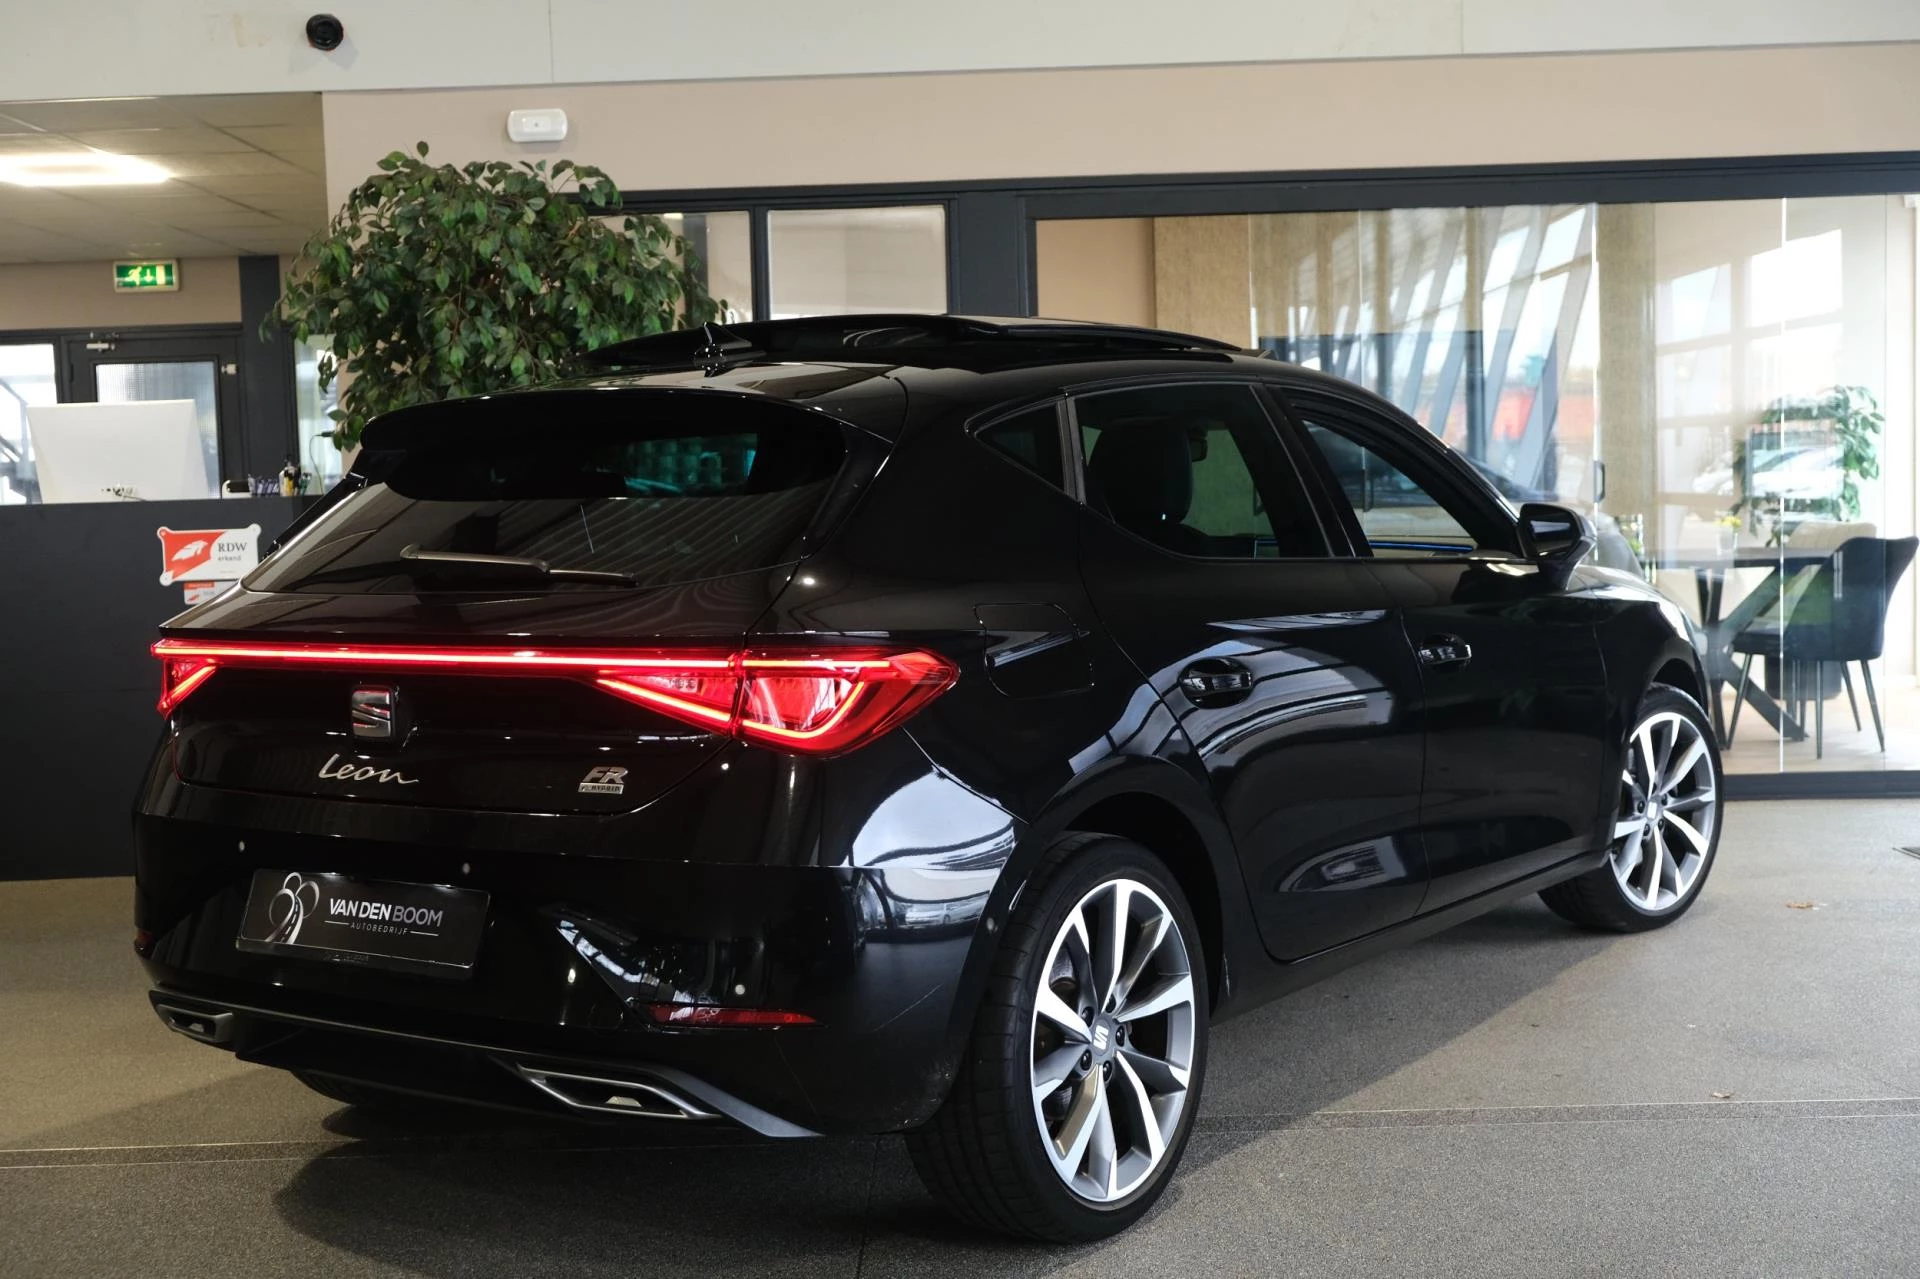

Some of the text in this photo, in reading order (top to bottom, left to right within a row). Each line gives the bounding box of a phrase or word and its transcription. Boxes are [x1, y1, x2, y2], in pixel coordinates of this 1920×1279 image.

[217, 542, 248, 552] RDW
[318, 753, 419, 784] Leon
[582, 766, 629, 784] FR
[330, 898, 444, 927] VAN DEN BOOM
[350, 922, 408, 936] AUTOBEDRIJF
